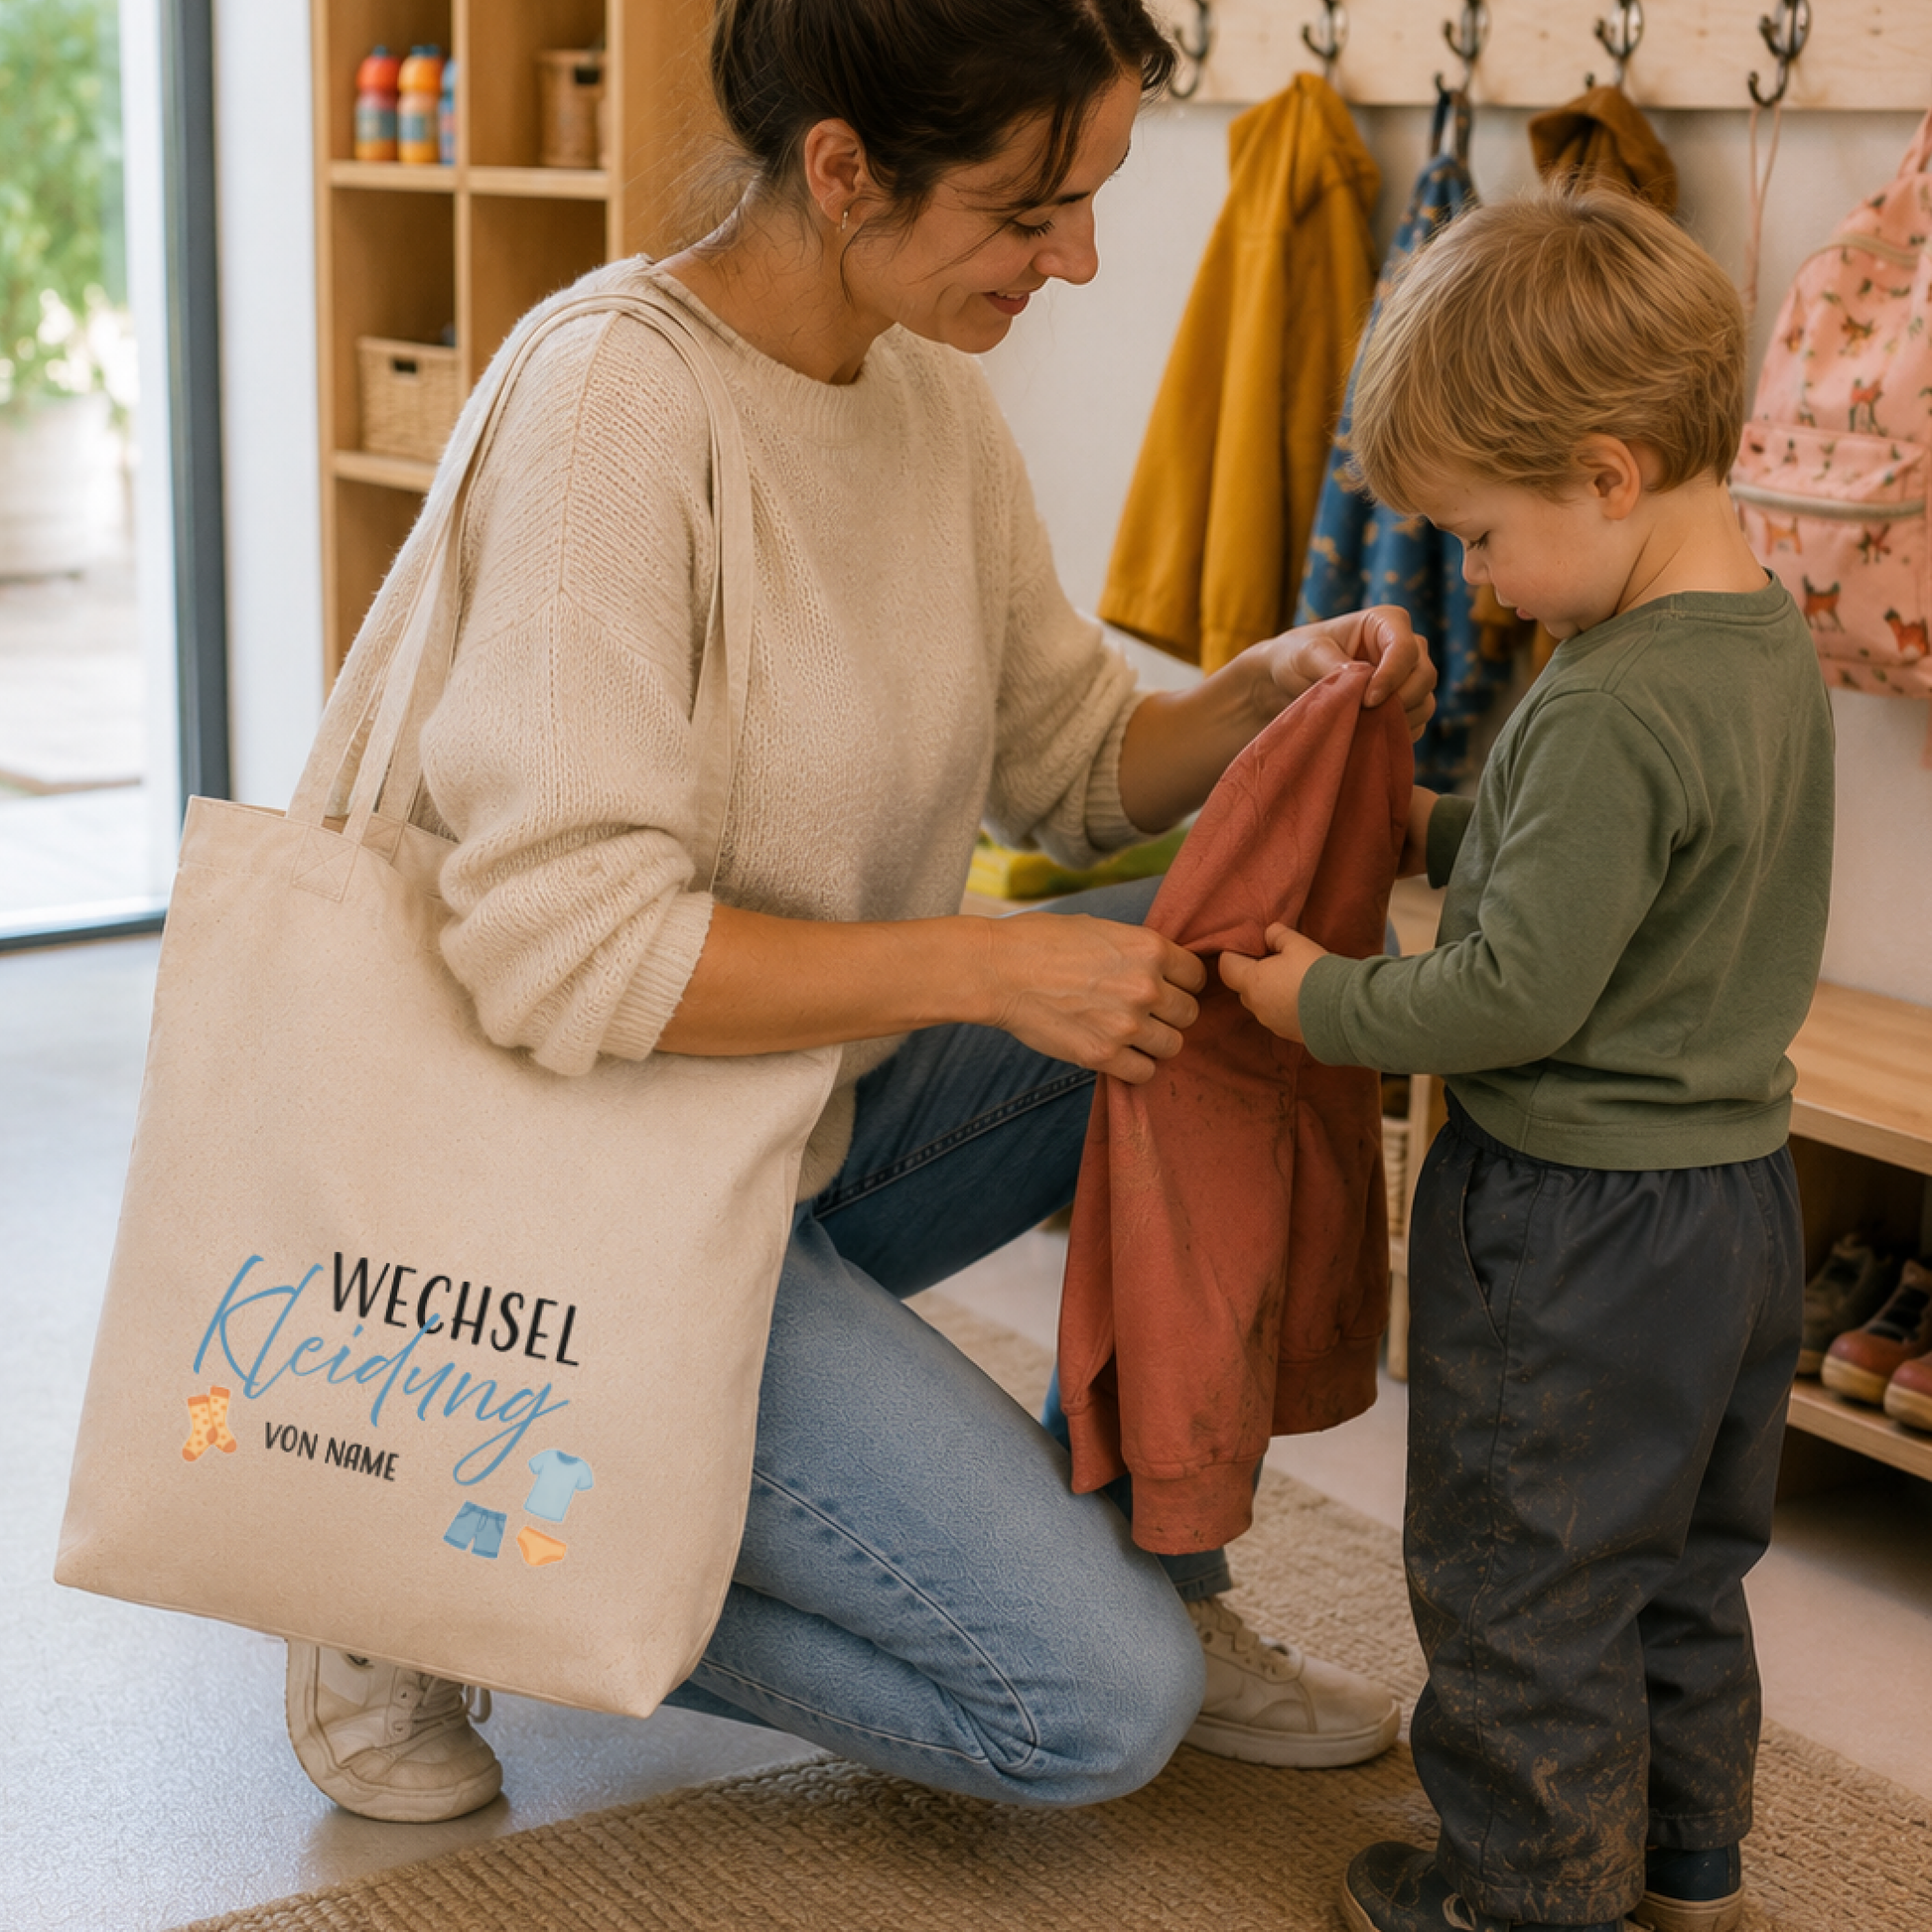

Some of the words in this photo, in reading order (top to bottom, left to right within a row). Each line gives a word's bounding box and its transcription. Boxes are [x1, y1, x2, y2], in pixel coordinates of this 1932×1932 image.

[334, 1252, 579, 1366] WECHSEL
[193, 1255, 570, 1486] Kleidung
[264, 1422, 319, 1460] VON
[325, 1437, 399, 1482] NAME
